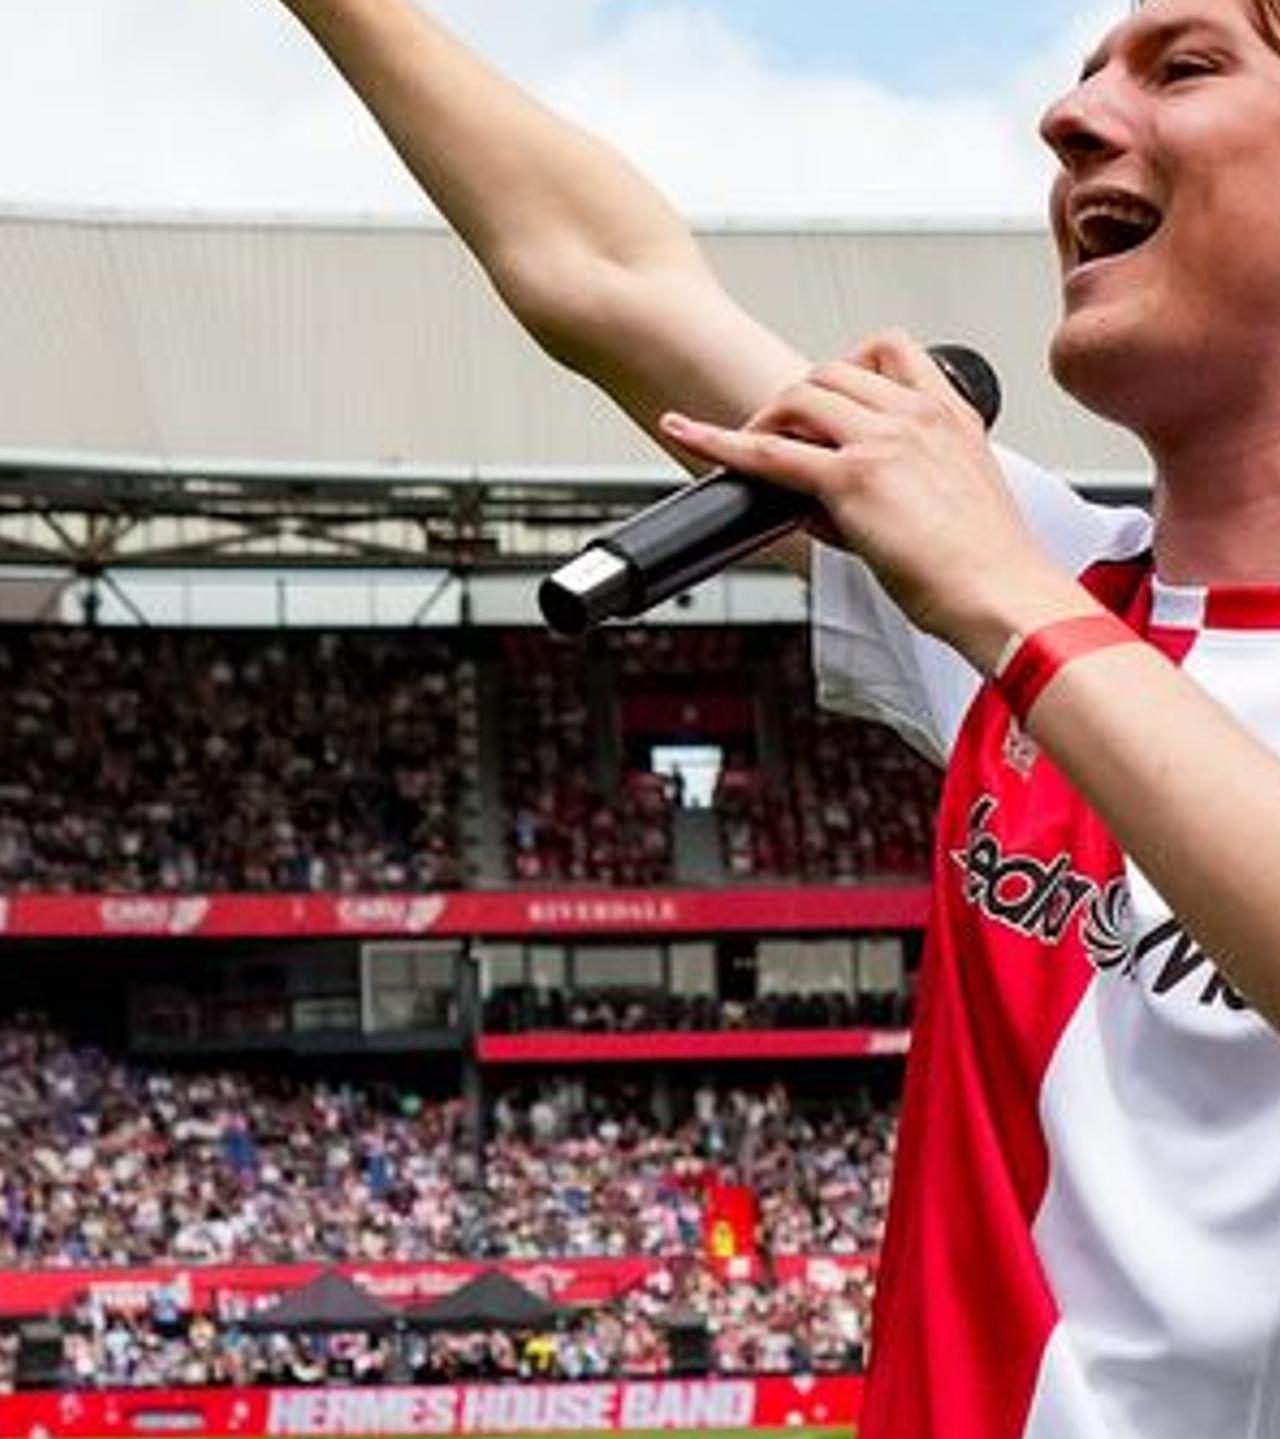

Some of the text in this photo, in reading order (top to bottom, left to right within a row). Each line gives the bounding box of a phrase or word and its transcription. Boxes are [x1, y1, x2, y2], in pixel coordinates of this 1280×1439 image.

[528, 901, 676, 922] RIVERDALE
[268, 1378, 755, 1436] HERMES HOUSE BAND
